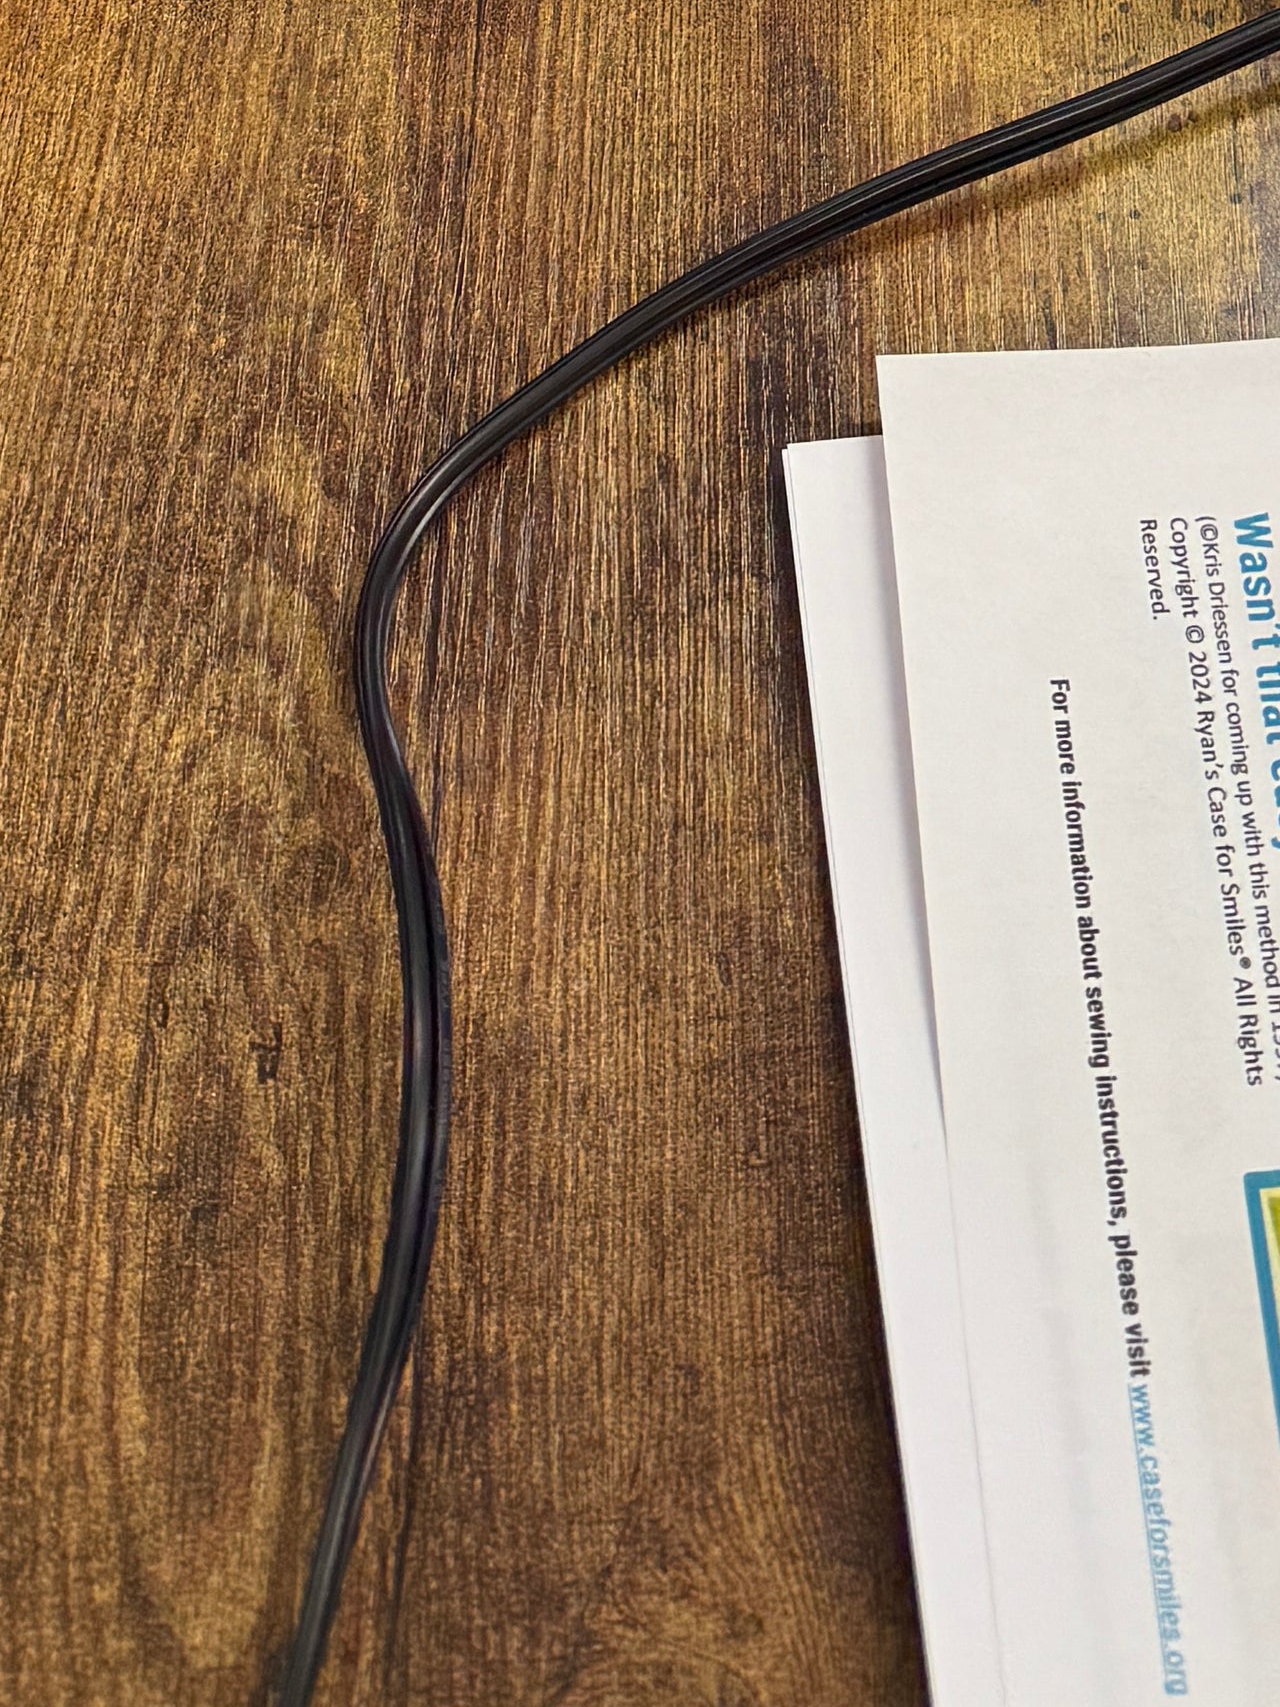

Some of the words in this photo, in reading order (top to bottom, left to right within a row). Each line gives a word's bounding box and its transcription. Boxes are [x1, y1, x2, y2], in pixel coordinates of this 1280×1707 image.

[1139, 519, 1170, 620] Reserved.
[1168, 517, 1199, 618] Copyright
[1207, 582, 1231, 664] Driessen
[1049, 679, 1070, 714] For
[1188, 651, 1212, 704] 2024
[1220, 668, 1239, 696] for
[1054, 720, 1074, 774] more
[1225, 702, 1249, 775] coming
[1207, 786, 1226, 837] Case
[1233, 780, 1252, 806] up
[1061, 781, 1092, 909] information
[1214, 844, 1235, 877] for
[1241, 811, 1264, 857] with
[1247, 862, 1269, 900] this
[1076, 916, 1102, 980] about
[1232, 977, 1256, 1007] All
[1085, 986, 1111, 1068] sewing
[1236, 1014, 1263, 1086] Rights
[1095, 1075, 1127, 1226] instructions,
[1107, 1235, 1138, 1315] please
[1125, 1323, 1150, 1377] visit
[1127, 1384, 1187, 1695] www.caseforsmiles.org
